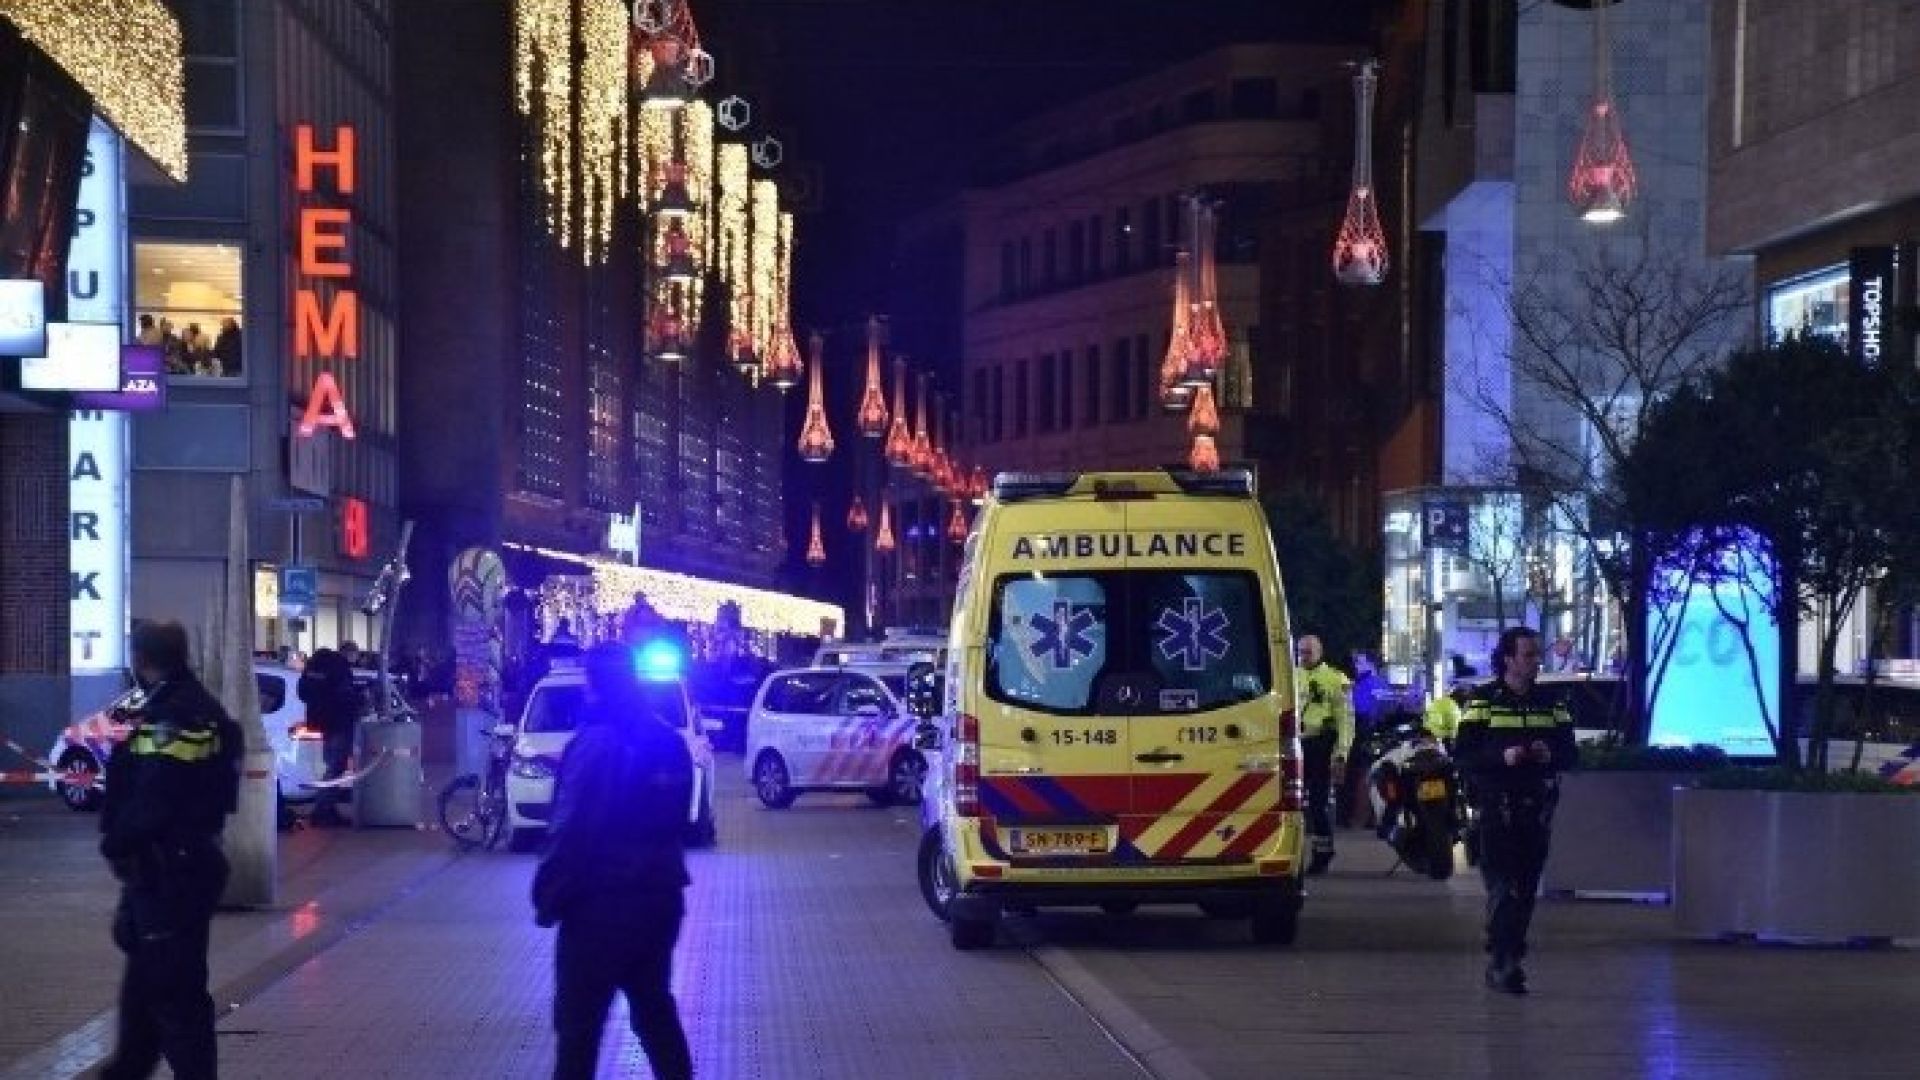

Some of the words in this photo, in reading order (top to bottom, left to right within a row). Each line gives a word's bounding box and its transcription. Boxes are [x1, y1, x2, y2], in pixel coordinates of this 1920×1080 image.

[296, 124, 355, 439] HEMA
[1012, 533, 1245, 559] AMBULANCE
[1050, 728, 1117, 745] 15-148
[1188, 726, 1218, 744] 112
